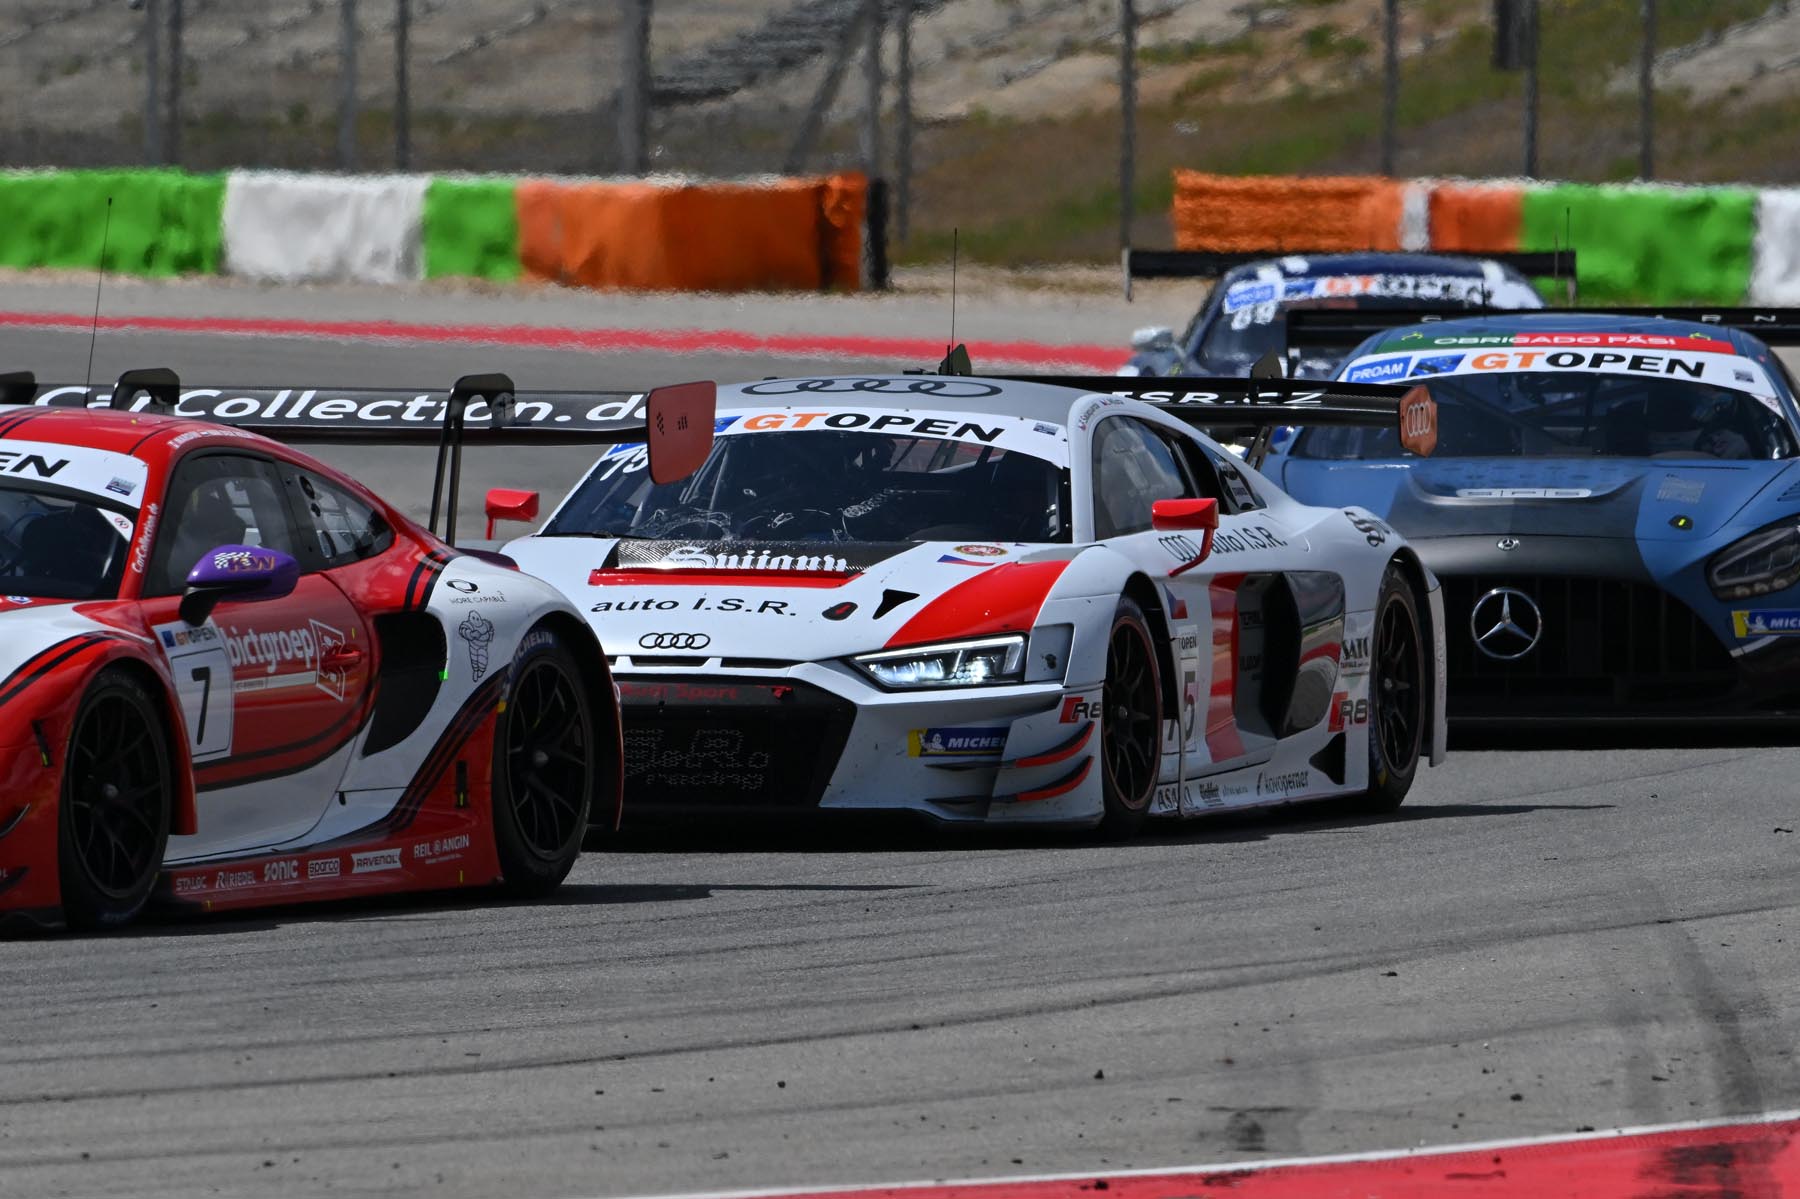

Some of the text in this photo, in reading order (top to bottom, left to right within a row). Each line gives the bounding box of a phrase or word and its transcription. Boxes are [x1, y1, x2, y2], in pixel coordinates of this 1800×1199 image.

[1434, 335, 1600, 345] OBRIGADO
[1350, 362, 1404, 383] PROAM
[591, 597, 797, 617] auto I.S.R.
[191, 666, 210, 746] 7
